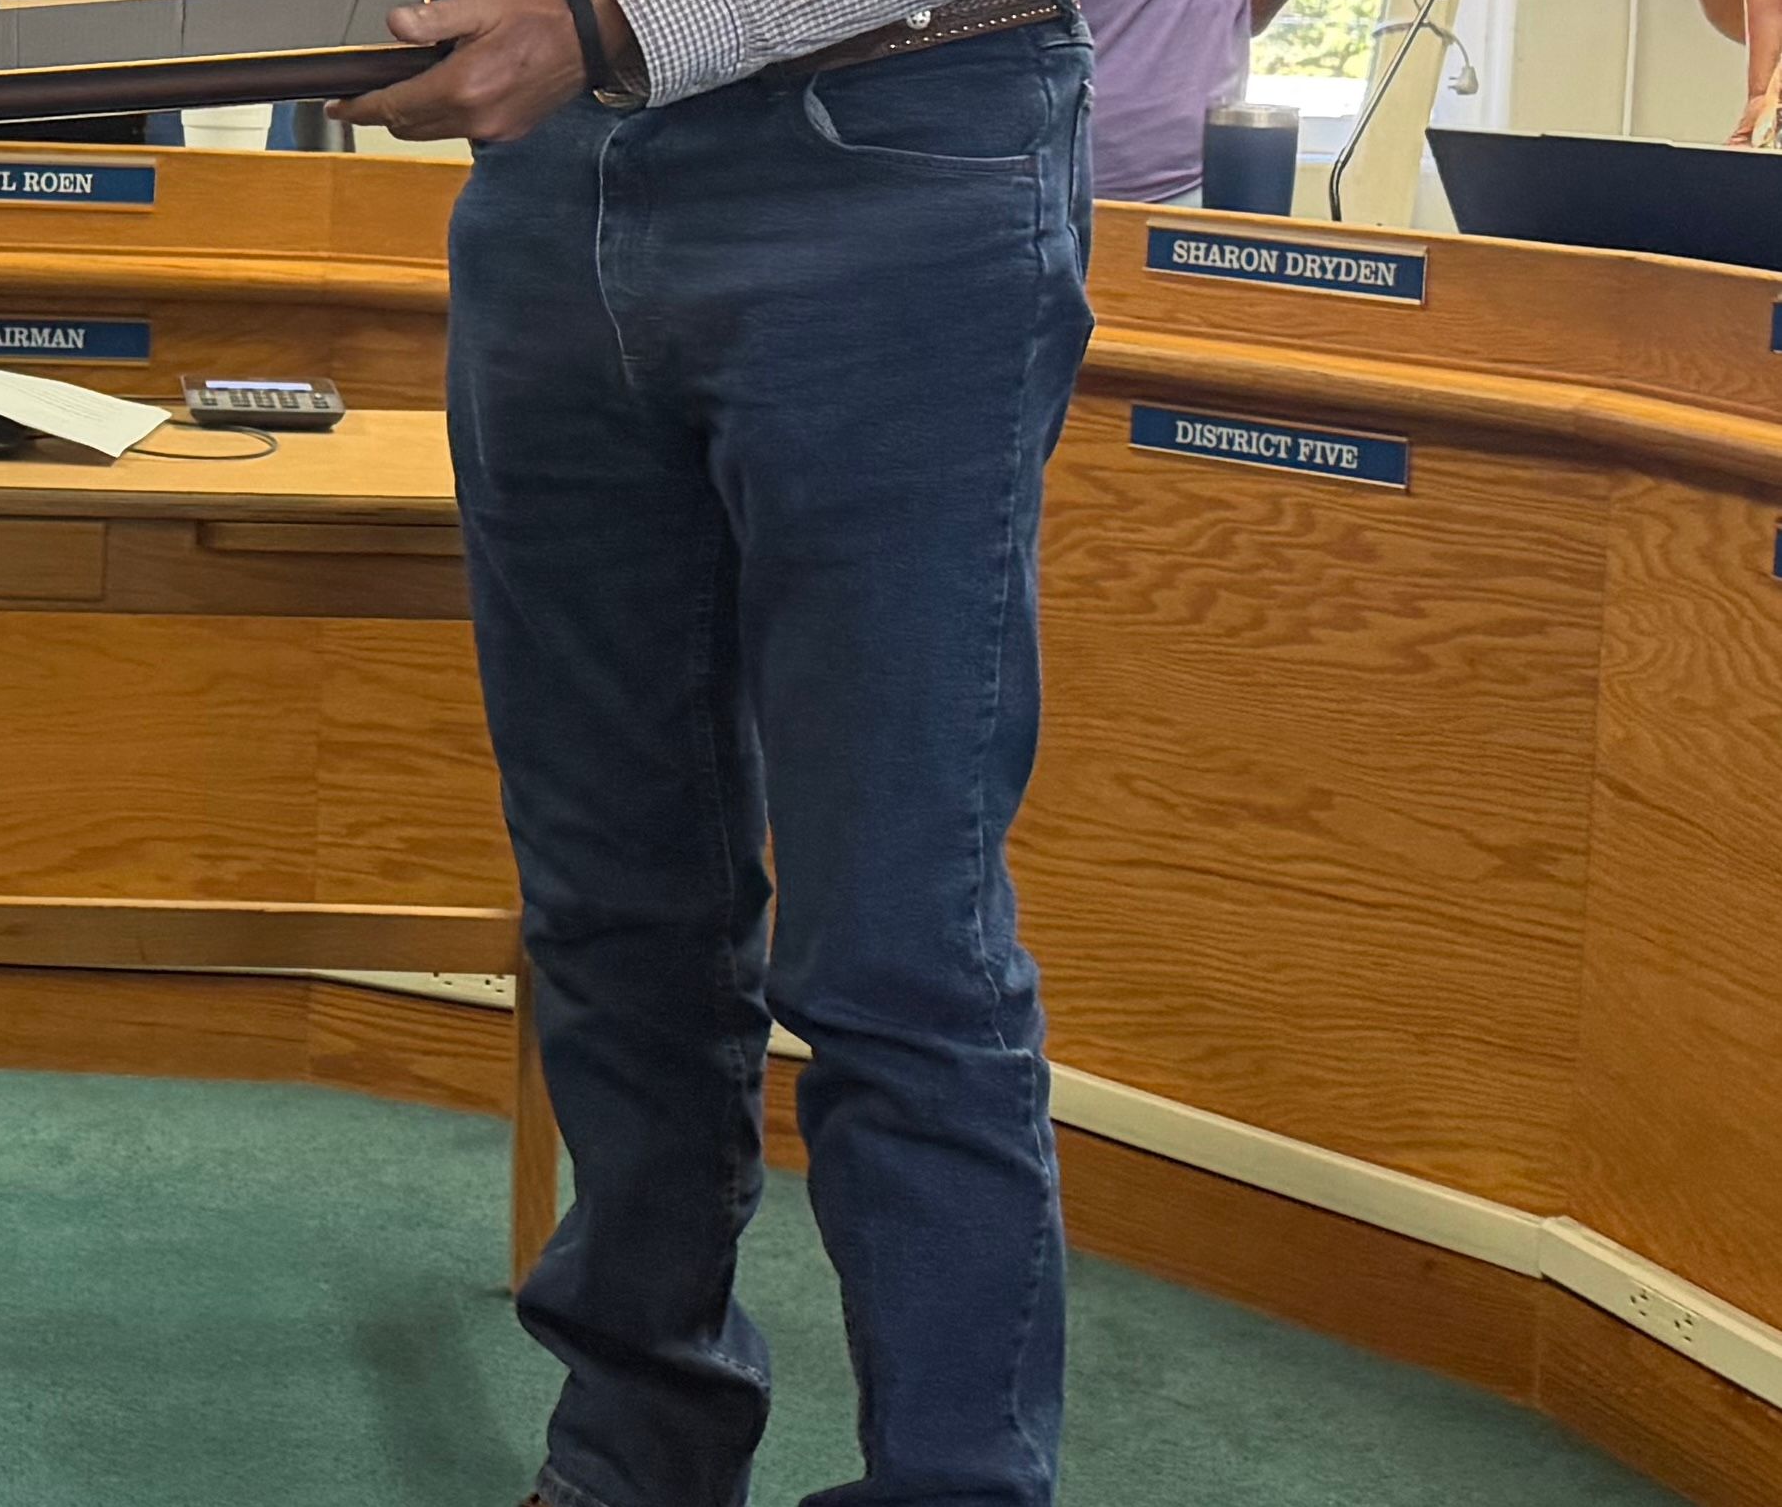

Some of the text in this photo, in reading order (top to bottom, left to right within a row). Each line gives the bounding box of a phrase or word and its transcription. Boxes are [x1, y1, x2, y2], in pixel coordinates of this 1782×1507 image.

[23, 172, 94, 194] ROEN
[1172, 240, 1398, 287] SHARON DRYDEN
[1175, 420, 1359, 470] DISTRICT FIVE
